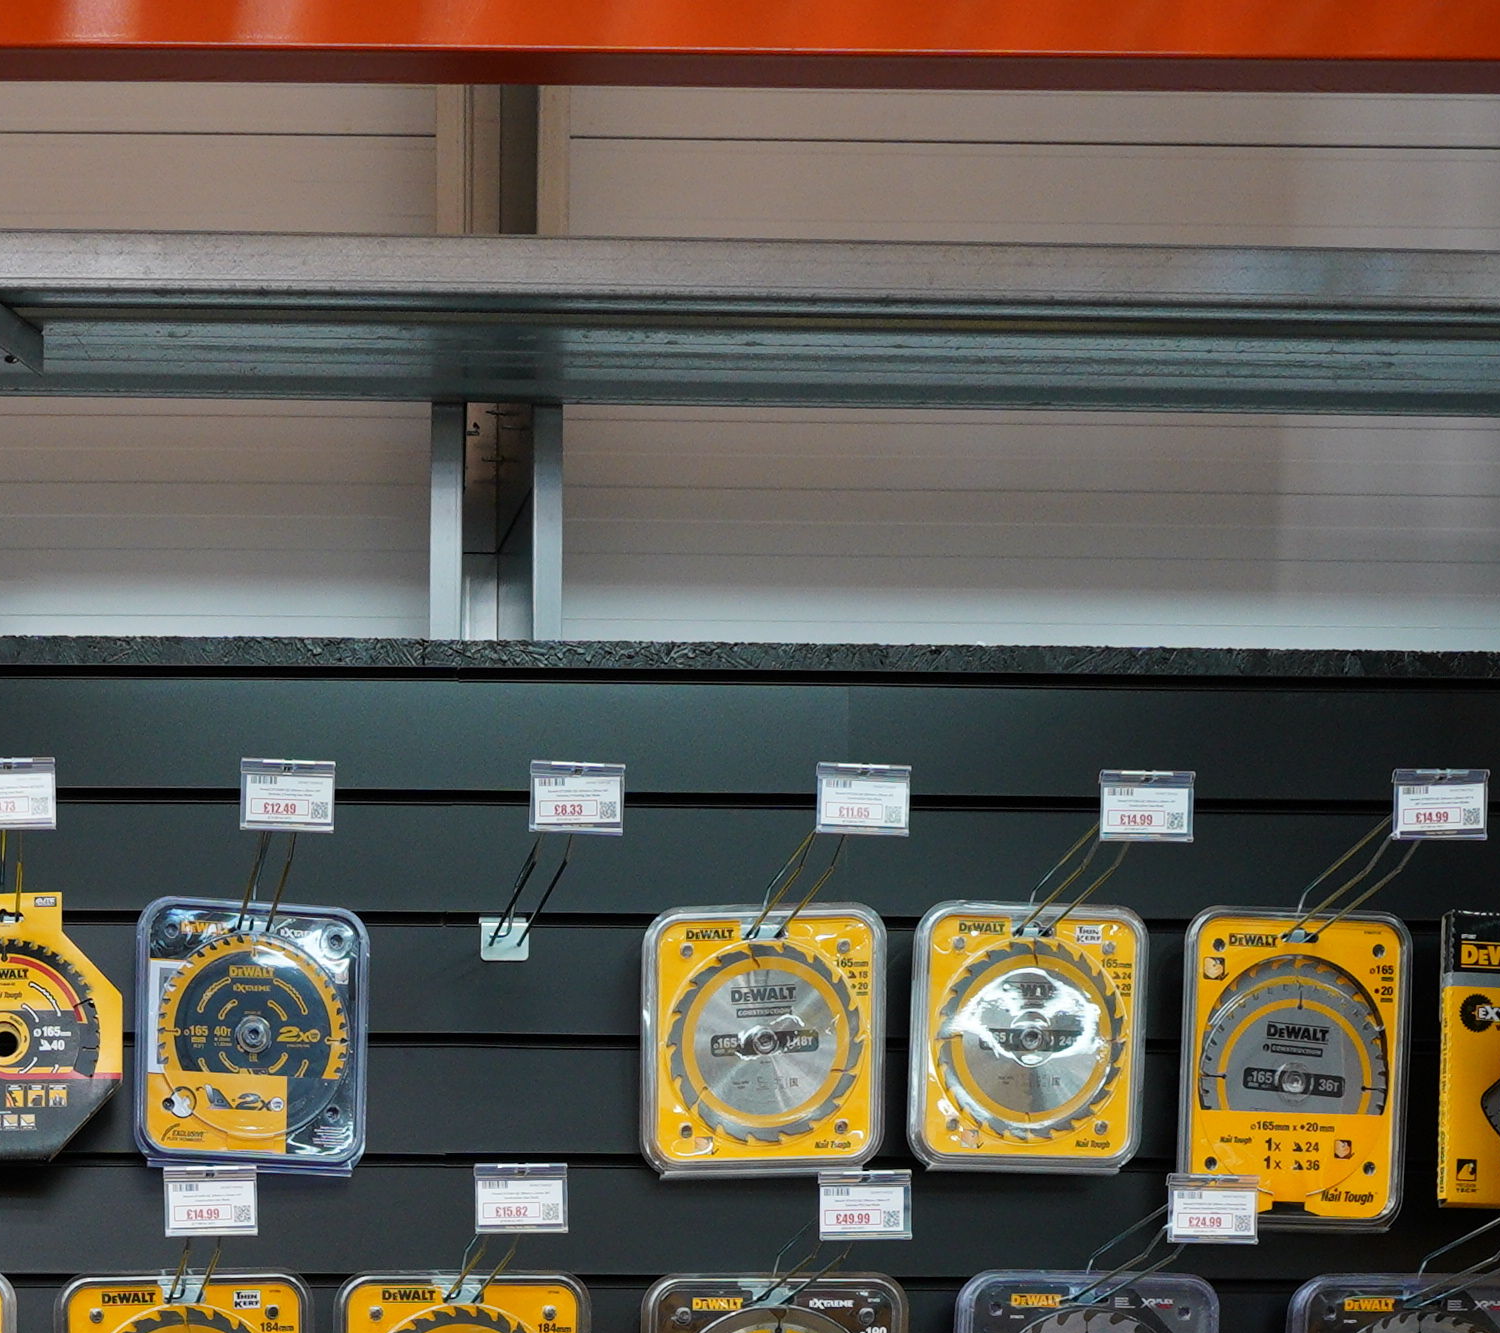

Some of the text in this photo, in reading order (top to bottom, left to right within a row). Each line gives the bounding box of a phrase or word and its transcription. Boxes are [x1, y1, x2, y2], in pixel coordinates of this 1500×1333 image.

[263, 803, 296, 814] £12.49
[554, 804, 583, 816] £8.33
[1120, 815, 1153, 826] £14.99
[1416, 812, 1449, 822] £14.99
[187, 1208, 220, 1219] £14.99
[497, 1207, 527, 1217] £15.82
[836, 1214, 872, 1224] £49.99
[1188, 1217, 1223, 1227] £24.99
